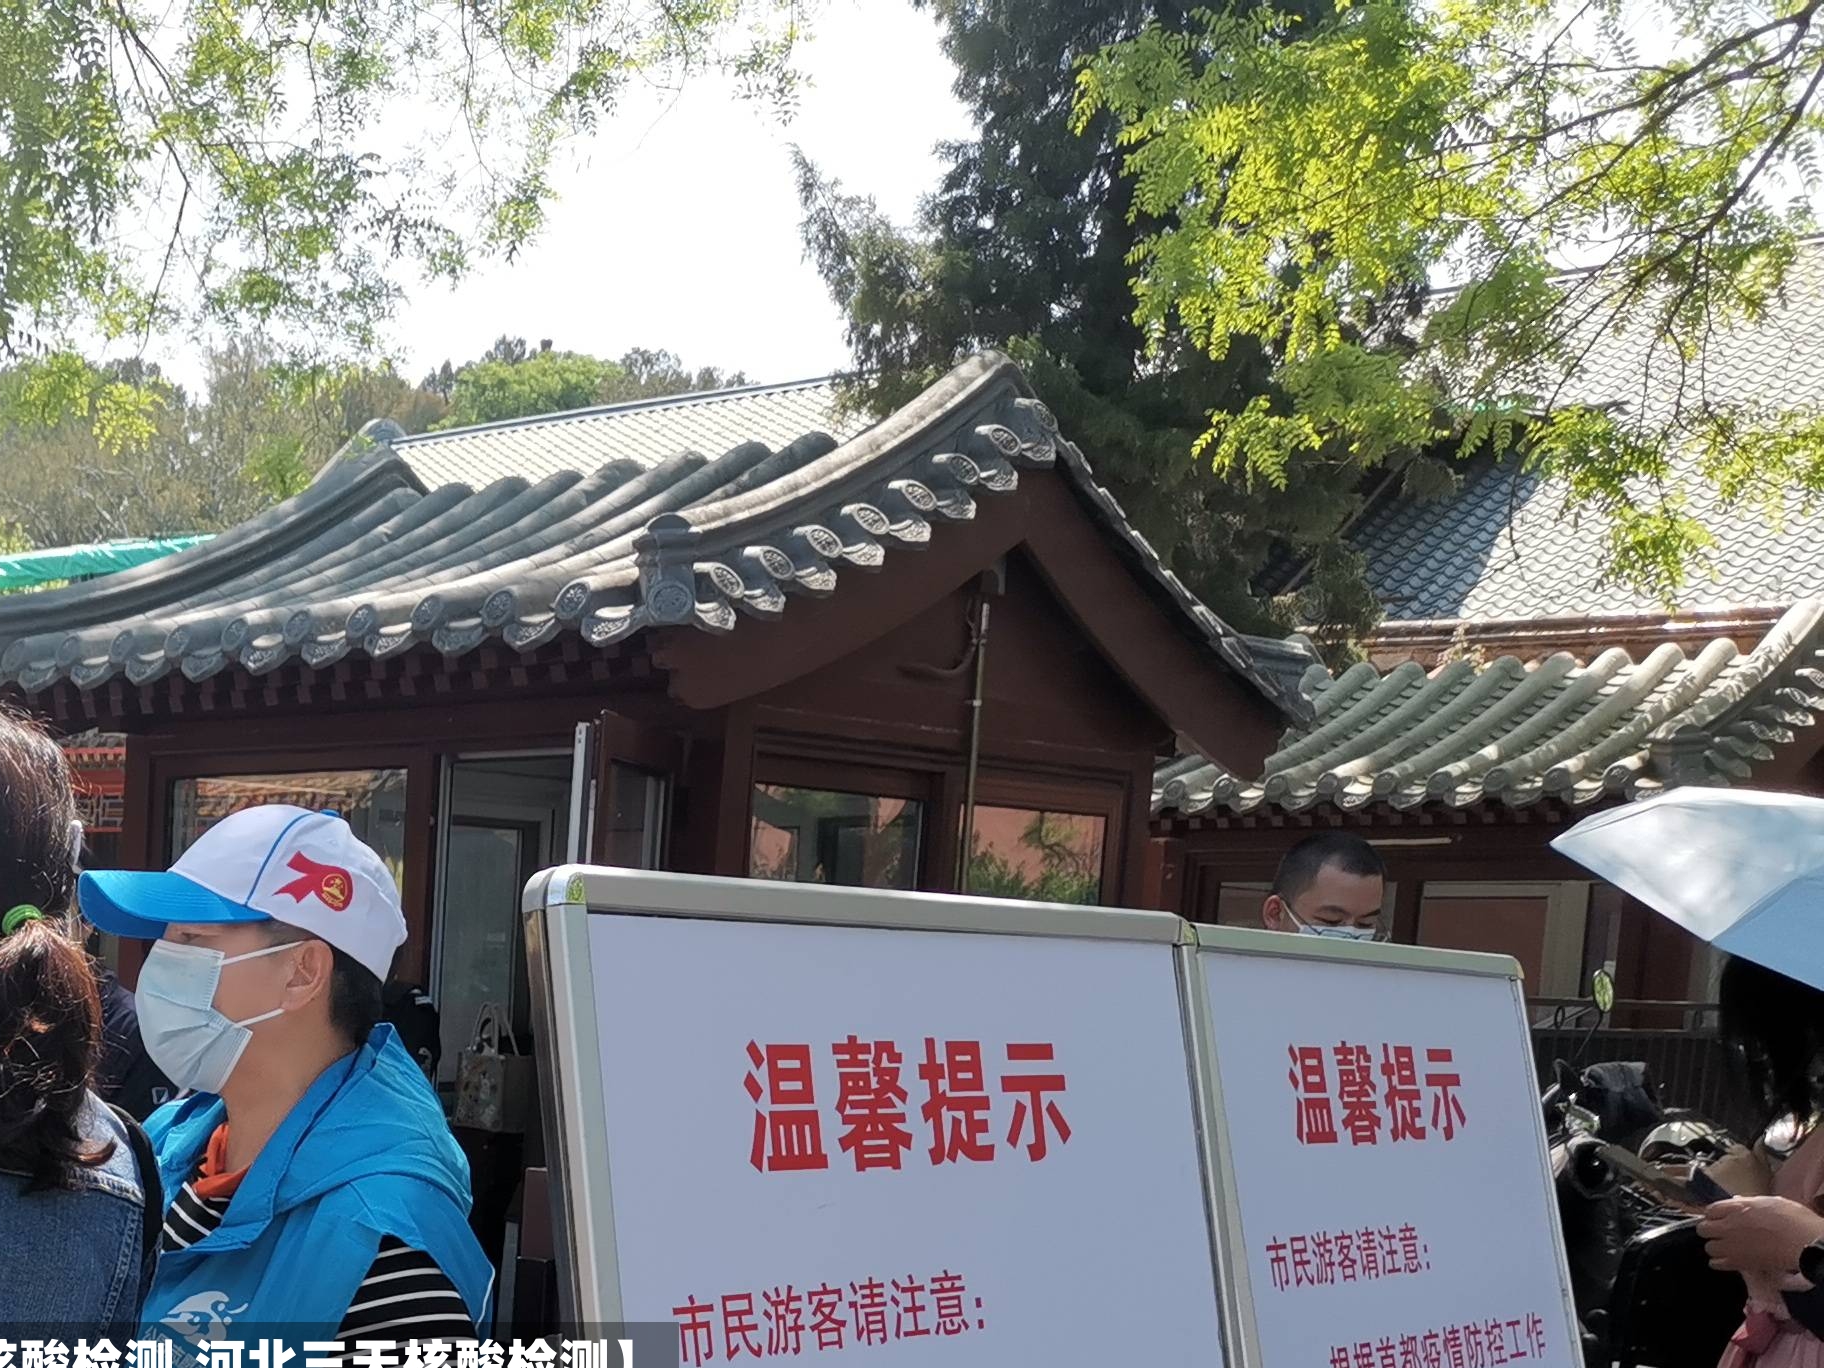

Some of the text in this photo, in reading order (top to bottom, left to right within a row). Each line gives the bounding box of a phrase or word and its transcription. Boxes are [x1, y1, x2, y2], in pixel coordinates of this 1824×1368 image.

[743, 1035, 1072, 1173] 温馨提示
[1288, 1041, 1466, 1146] 温馨提示
[1266, 1222, 1431, 1292] 市民游客请注意：
[672, 1269, 985, 1368] 市民游客请注意：
